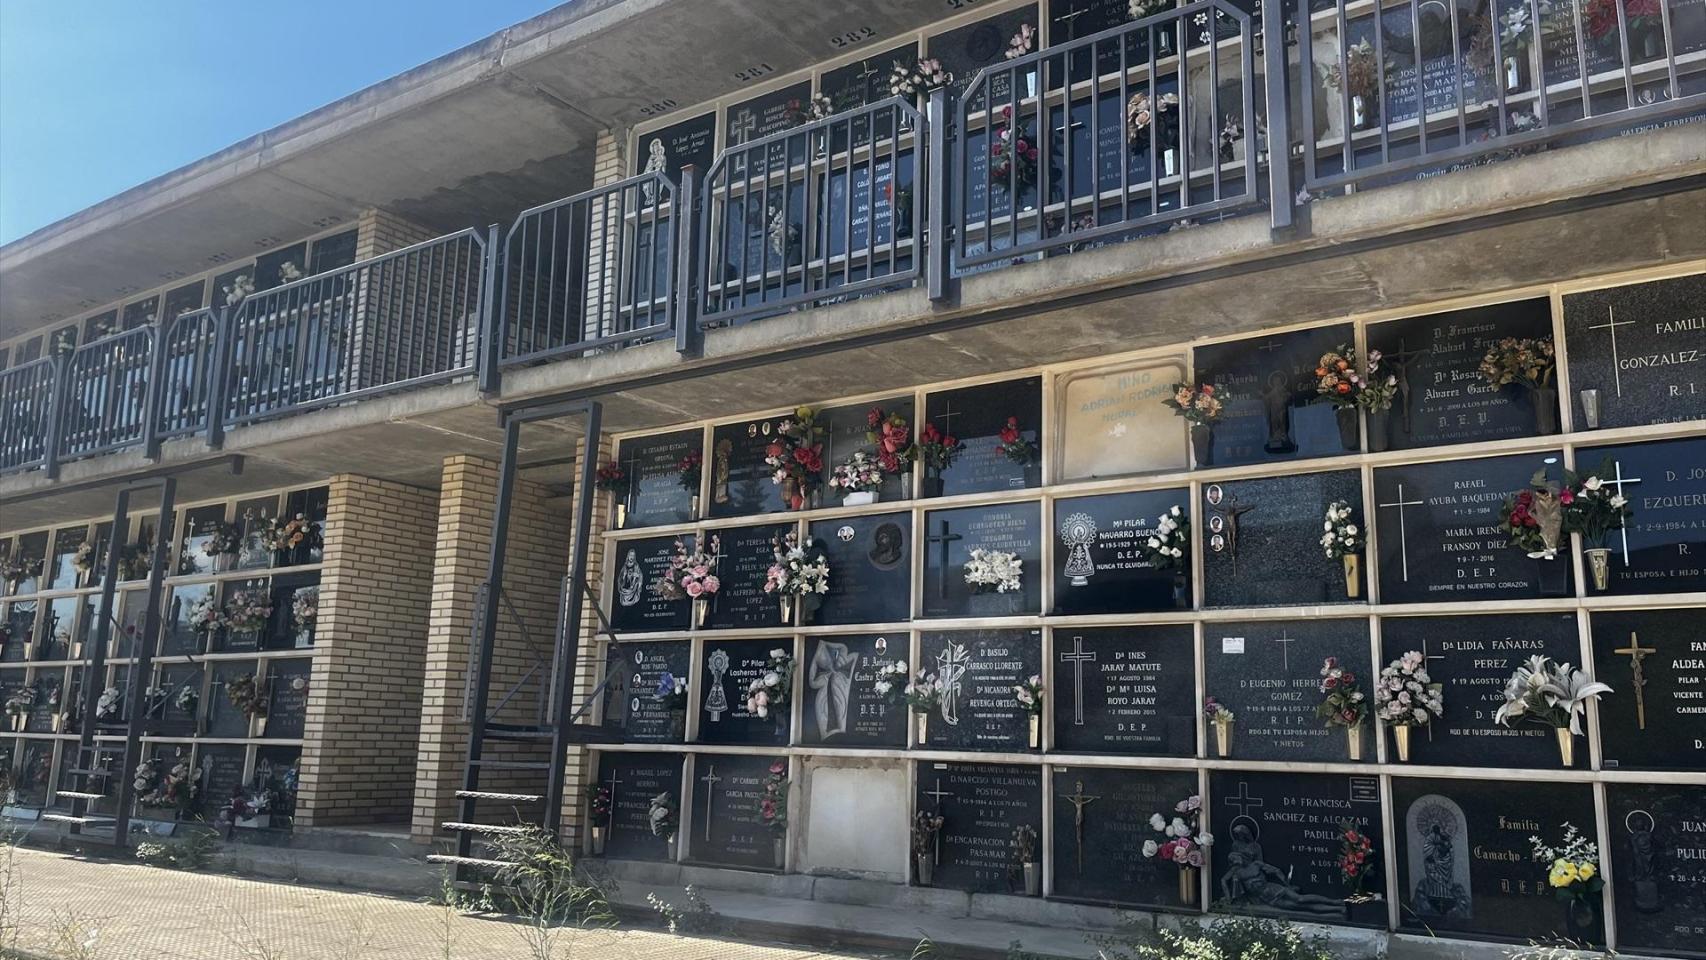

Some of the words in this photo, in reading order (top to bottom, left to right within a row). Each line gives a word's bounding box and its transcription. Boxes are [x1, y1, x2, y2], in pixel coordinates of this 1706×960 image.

[831, 26, 876, 48] 282
[735, 63, 775, 82] 281
[1388, 83, 1428, 98] TOMAA
[1434, 73, 1469, 88] MARO
[640, 98, 677, 116] 280
[1656, 317, 1706, 334] FAMILI
[1620, 350, 1699, 370] GONZALEZ
[1129, 384, 1174, 402] RODRIG
[1454, 480, 1486, 490] RAFAEL
[1429, 496, 1457, 506] AYUBA
[1124, 518, 1146, 528] PILAR
[1100, 530, 1134, 540] NAVARRO
[1446, 526, 1474, 538] MARÍA
[1477, 526, 1502, 536] IRENE
[1442, 542, 1482, 552] FRANSOY
[1458, 641, 1485, 650] LIDIA
[1492, 637, 1544, 650] FAÑARAS
[1128, 652, 1146, 660] INES
[1100, 664, 1125, 672] JARAY
[1128, 663, 1162, 672] MATUTE
[1474, 659, 1508, 669] PEREZ
[1672, 660, 1705, 669] ALDEA
[1250, 679, 1286, 688] EUGENIO
[1292, 678, 1322, 688] HERRE
[1134, 686, 1157, 694] LUISA
[1108, 697, 1128, 705] ROYO
[1131, 697, 1156, 706] JARAY
[1301, 798, 1352, 809] FRANCISCA
[1264, 812, 1306, 822] SANCHEZ
[1309, 815, 1320, 823] DE
[1323, 816, 1368, 826] ALCAZAR
[1498, 815, 1540, 832] Familia
[1474, 846, 1521, 862] Camacho
